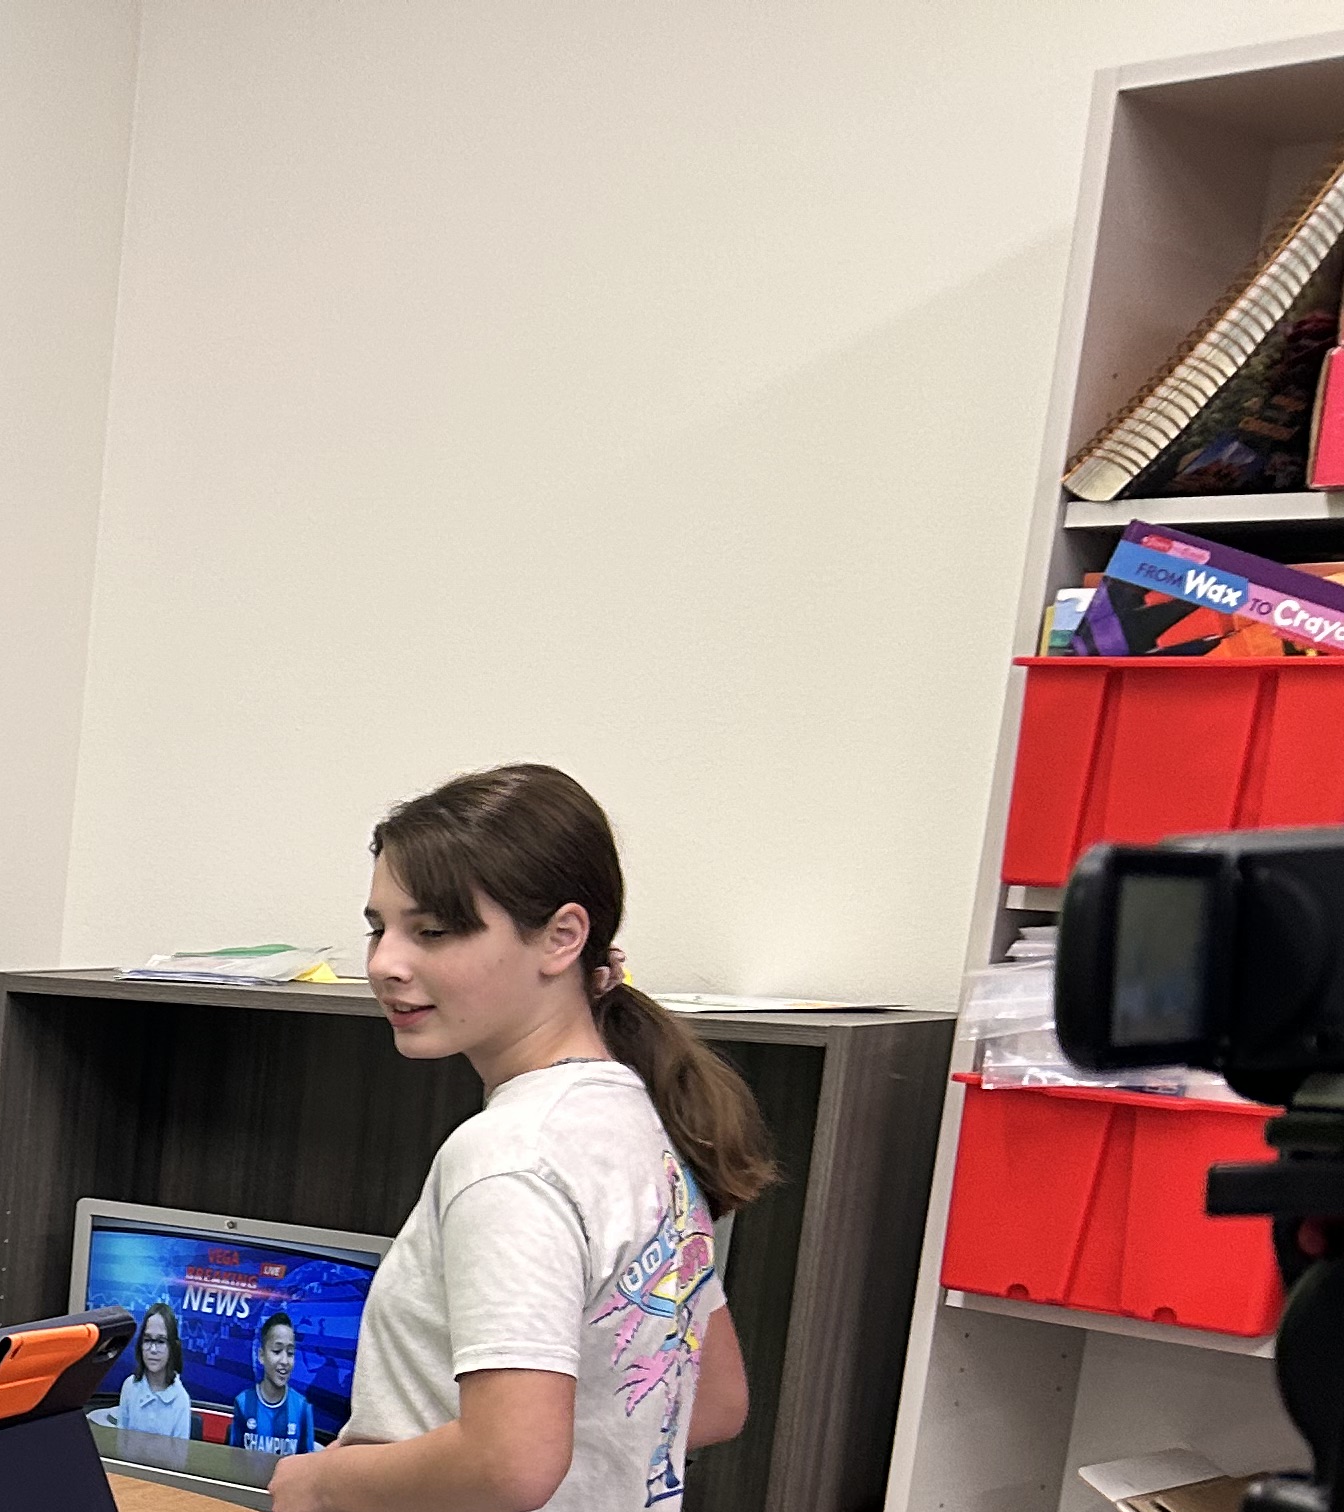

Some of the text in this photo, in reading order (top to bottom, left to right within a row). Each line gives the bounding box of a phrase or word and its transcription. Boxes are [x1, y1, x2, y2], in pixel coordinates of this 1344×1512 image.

[1136, 562, 1184, 589] FROM
[1183, 569, 1243, 607] Wax
[1248, 597, 1273, 615] TO
[208, 1248, 240, 1265] VEGA
[263, 1265, 282, 1277] LIVE
[182, 1284, 252, 1319] NEWS
